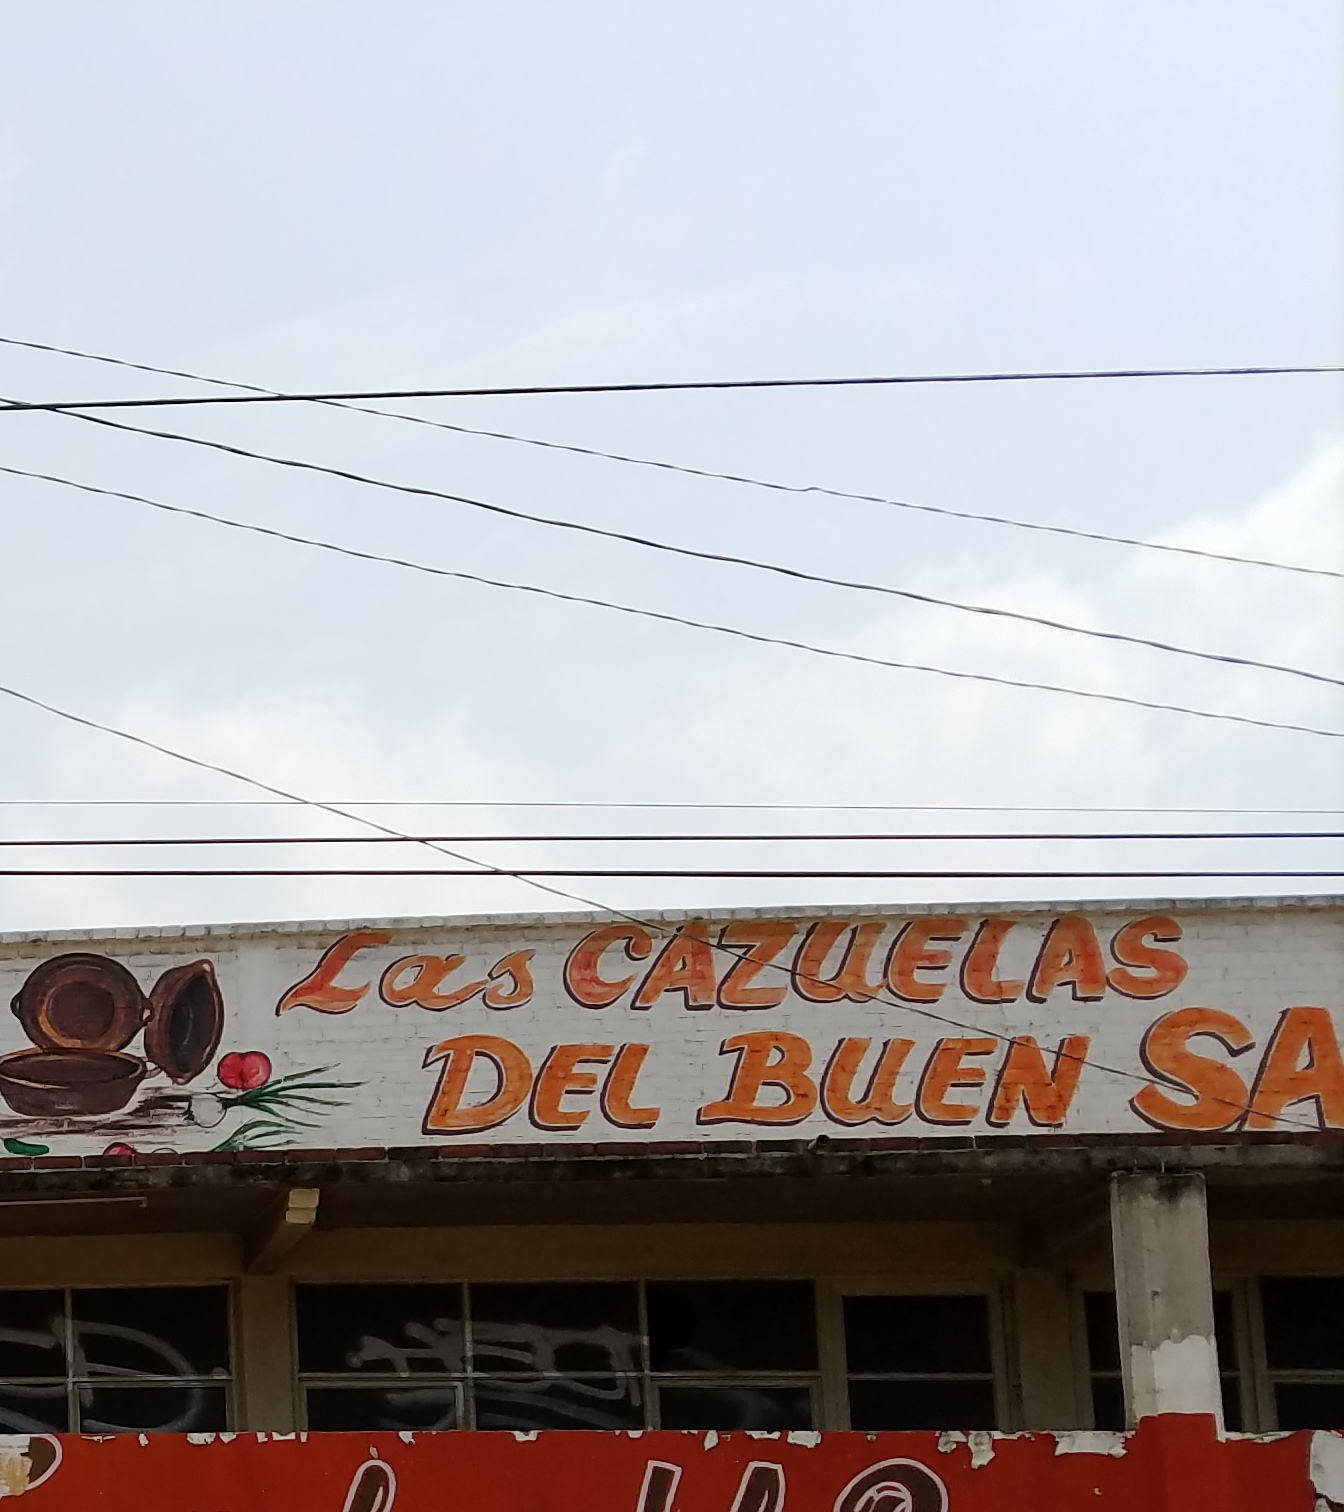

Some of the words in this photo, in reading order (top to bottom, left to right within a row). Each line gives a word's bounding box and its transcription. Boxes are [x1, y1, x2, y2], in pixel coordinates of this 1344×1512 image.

[276, 929, 538, 1016] Las
[561, 914, 1191, 1010] CAZUELAS
[421, 1031, 661, 1136] DEL
[696, 1027, 1090, 1129] BUEN
